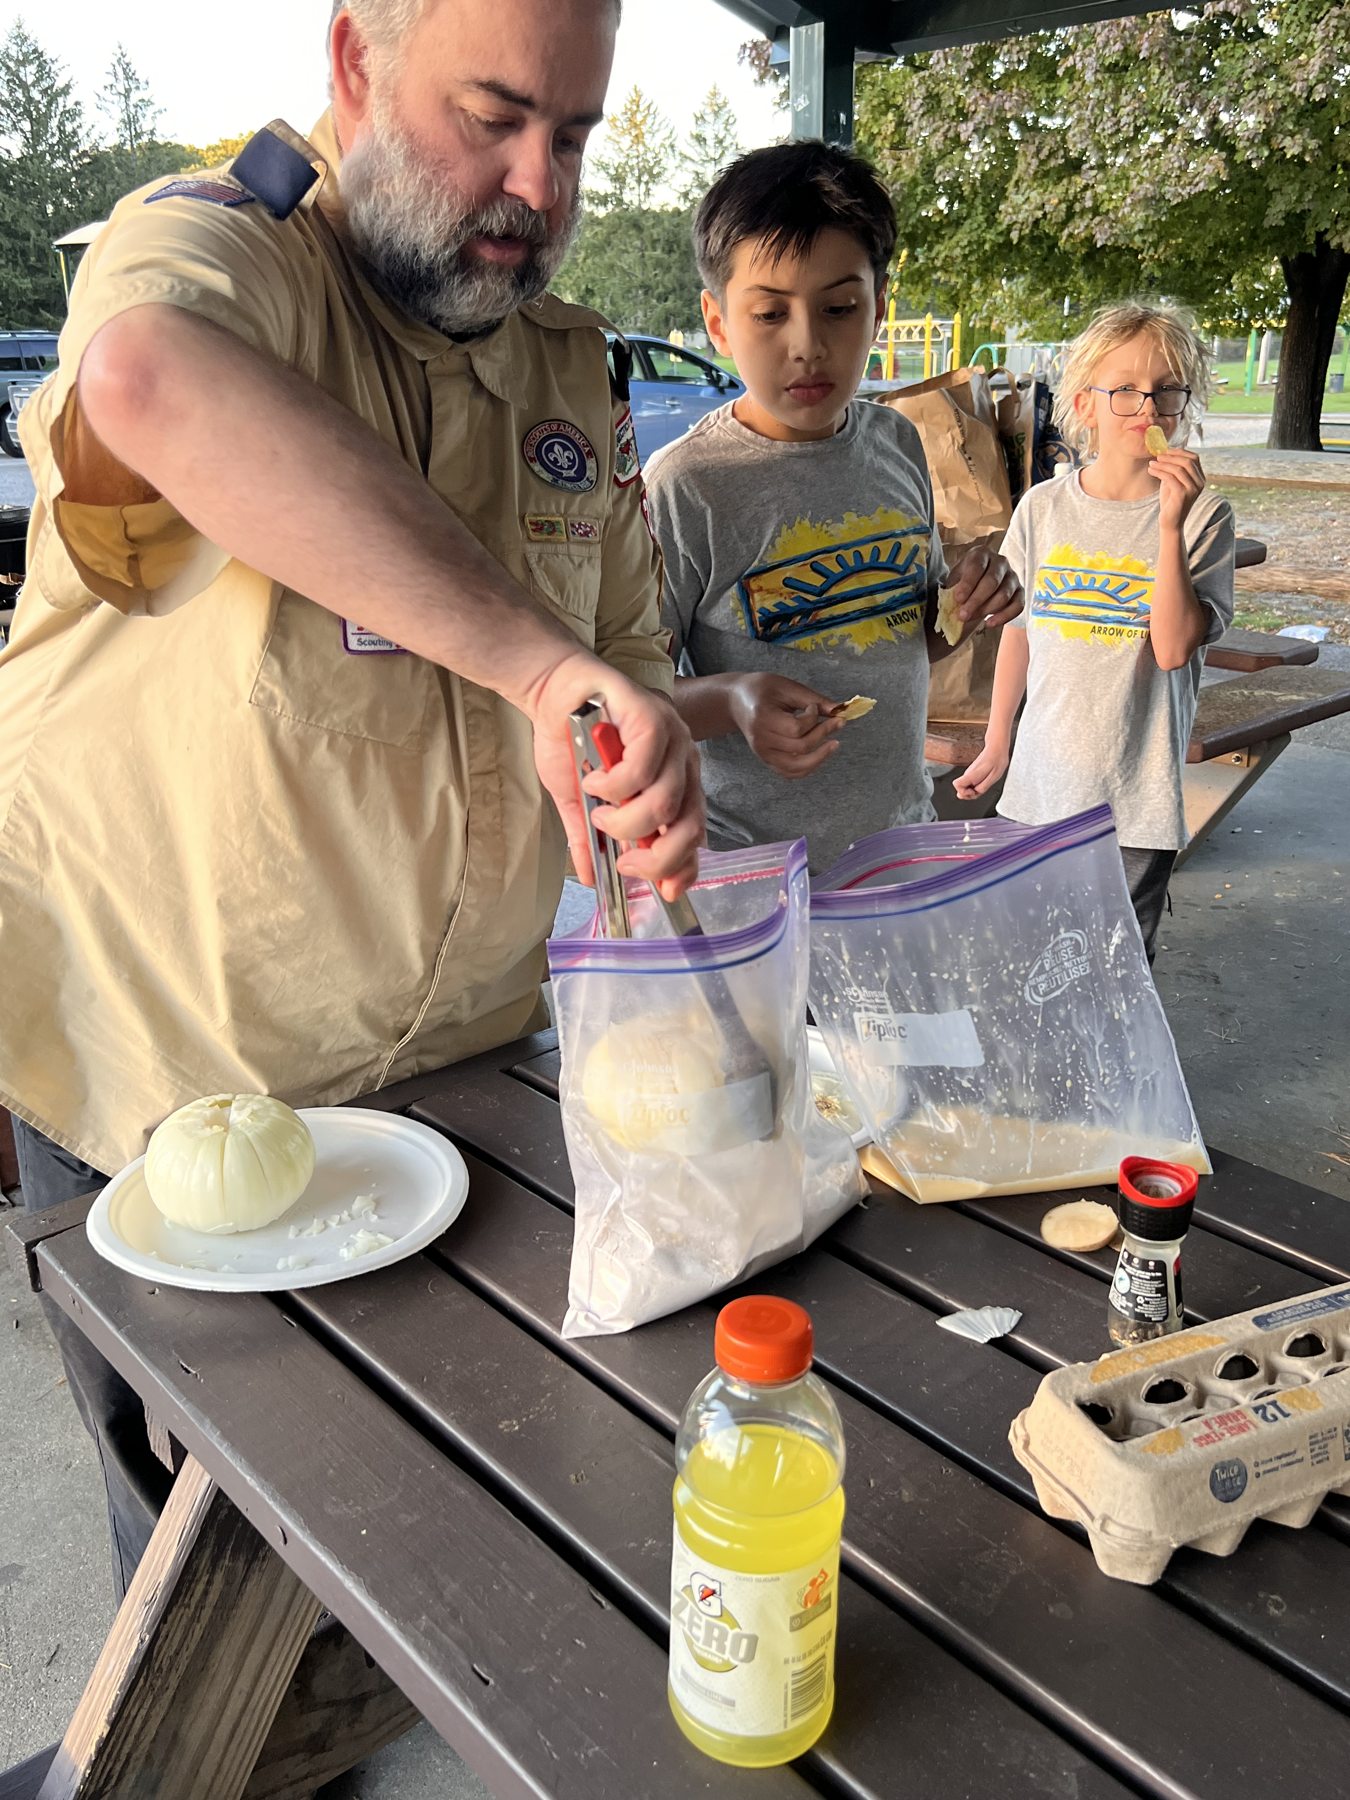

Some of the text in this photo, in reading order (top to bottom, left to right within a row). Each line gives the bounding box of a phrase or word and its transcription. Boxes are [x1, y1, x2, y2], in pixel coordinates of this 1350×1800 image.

[559, 424, 590, 453] AMERICA
[886, 608, 918, 628] ARROW
[1090, 625, 1125, 637] ARROW
[1126, 629, 1138, 639] OF
[356, 638, 393, 648] Scouting
[1251, 1400, 1292, 1423] 12
[671, 1588, 759, 1664] ZERO
